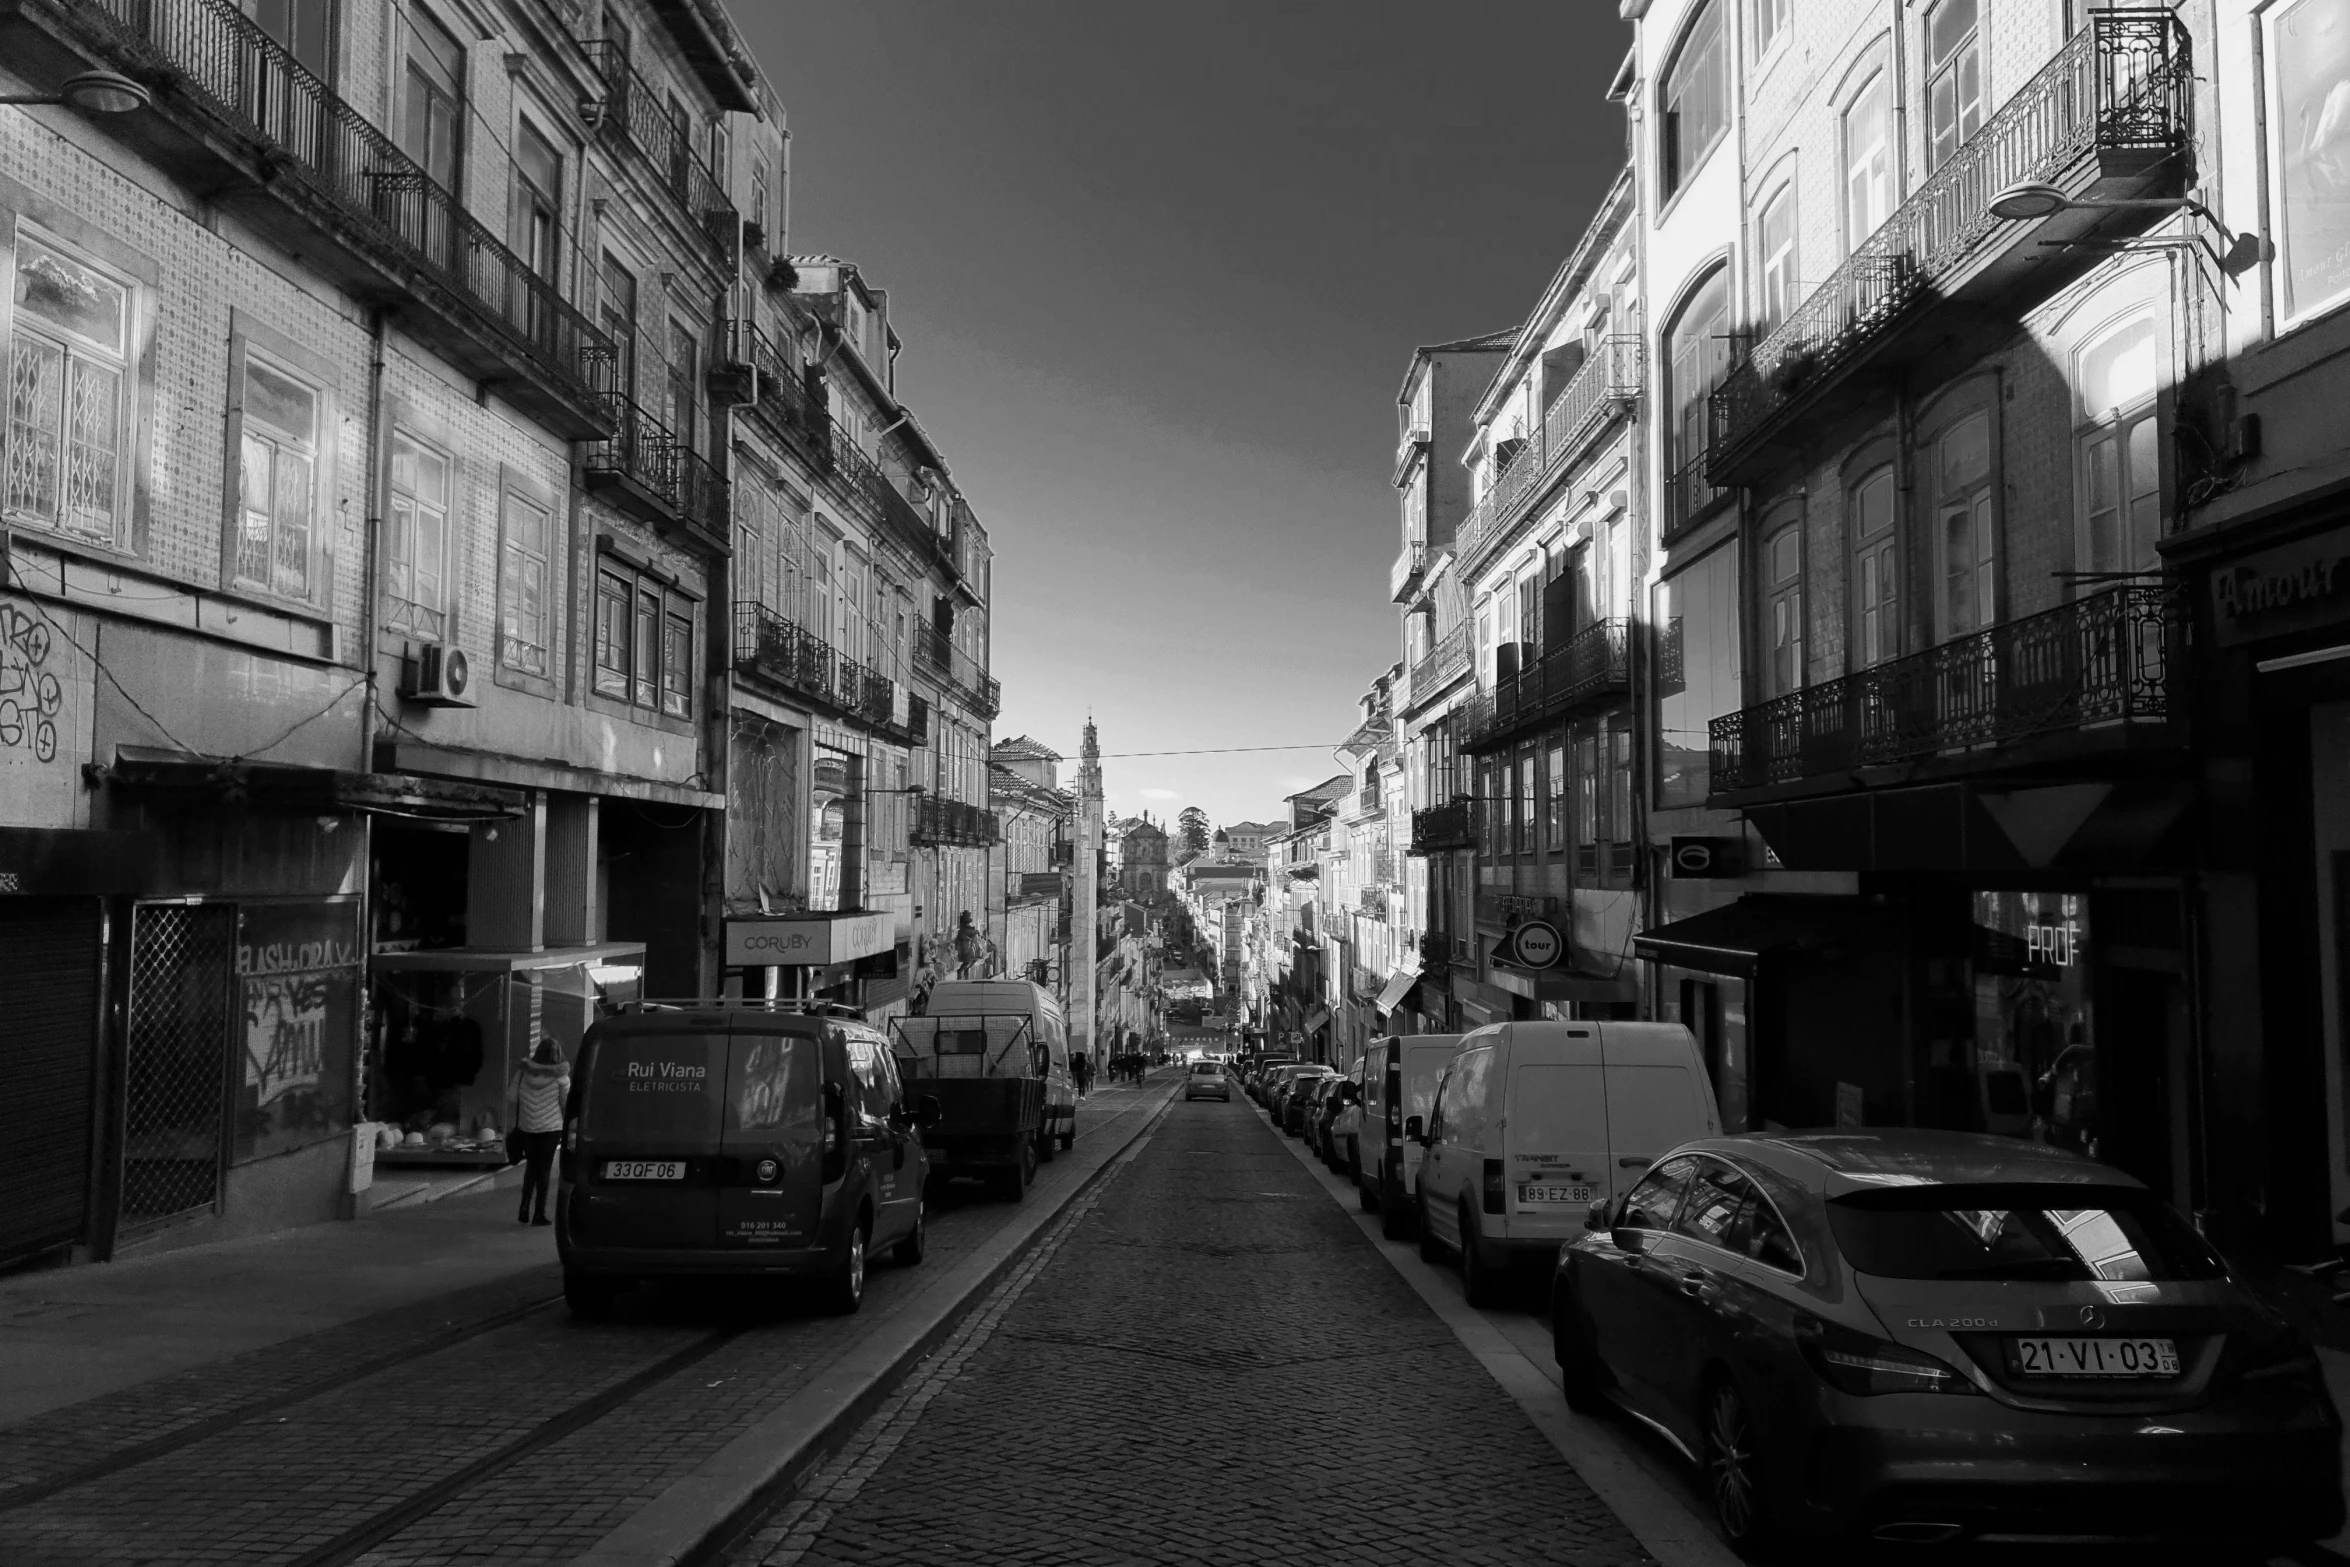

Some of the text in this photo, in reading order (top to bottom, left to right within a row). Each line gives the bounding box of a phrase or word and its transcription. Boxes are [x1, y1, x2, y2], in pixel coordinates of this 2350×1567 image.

[744, 934, 813, 954] CORUBY
[1525, 940, 1551, 950] tour
[2027, 924, 2082, 967] PROF
[627, 1061, 706, 1078] Rui Viana
[629, 1081, 701, 1092] ELETRICISTA
[741, 1221, 787, 1229] 916 201 340
[1907, 1318, 1945, 1328] CLA
